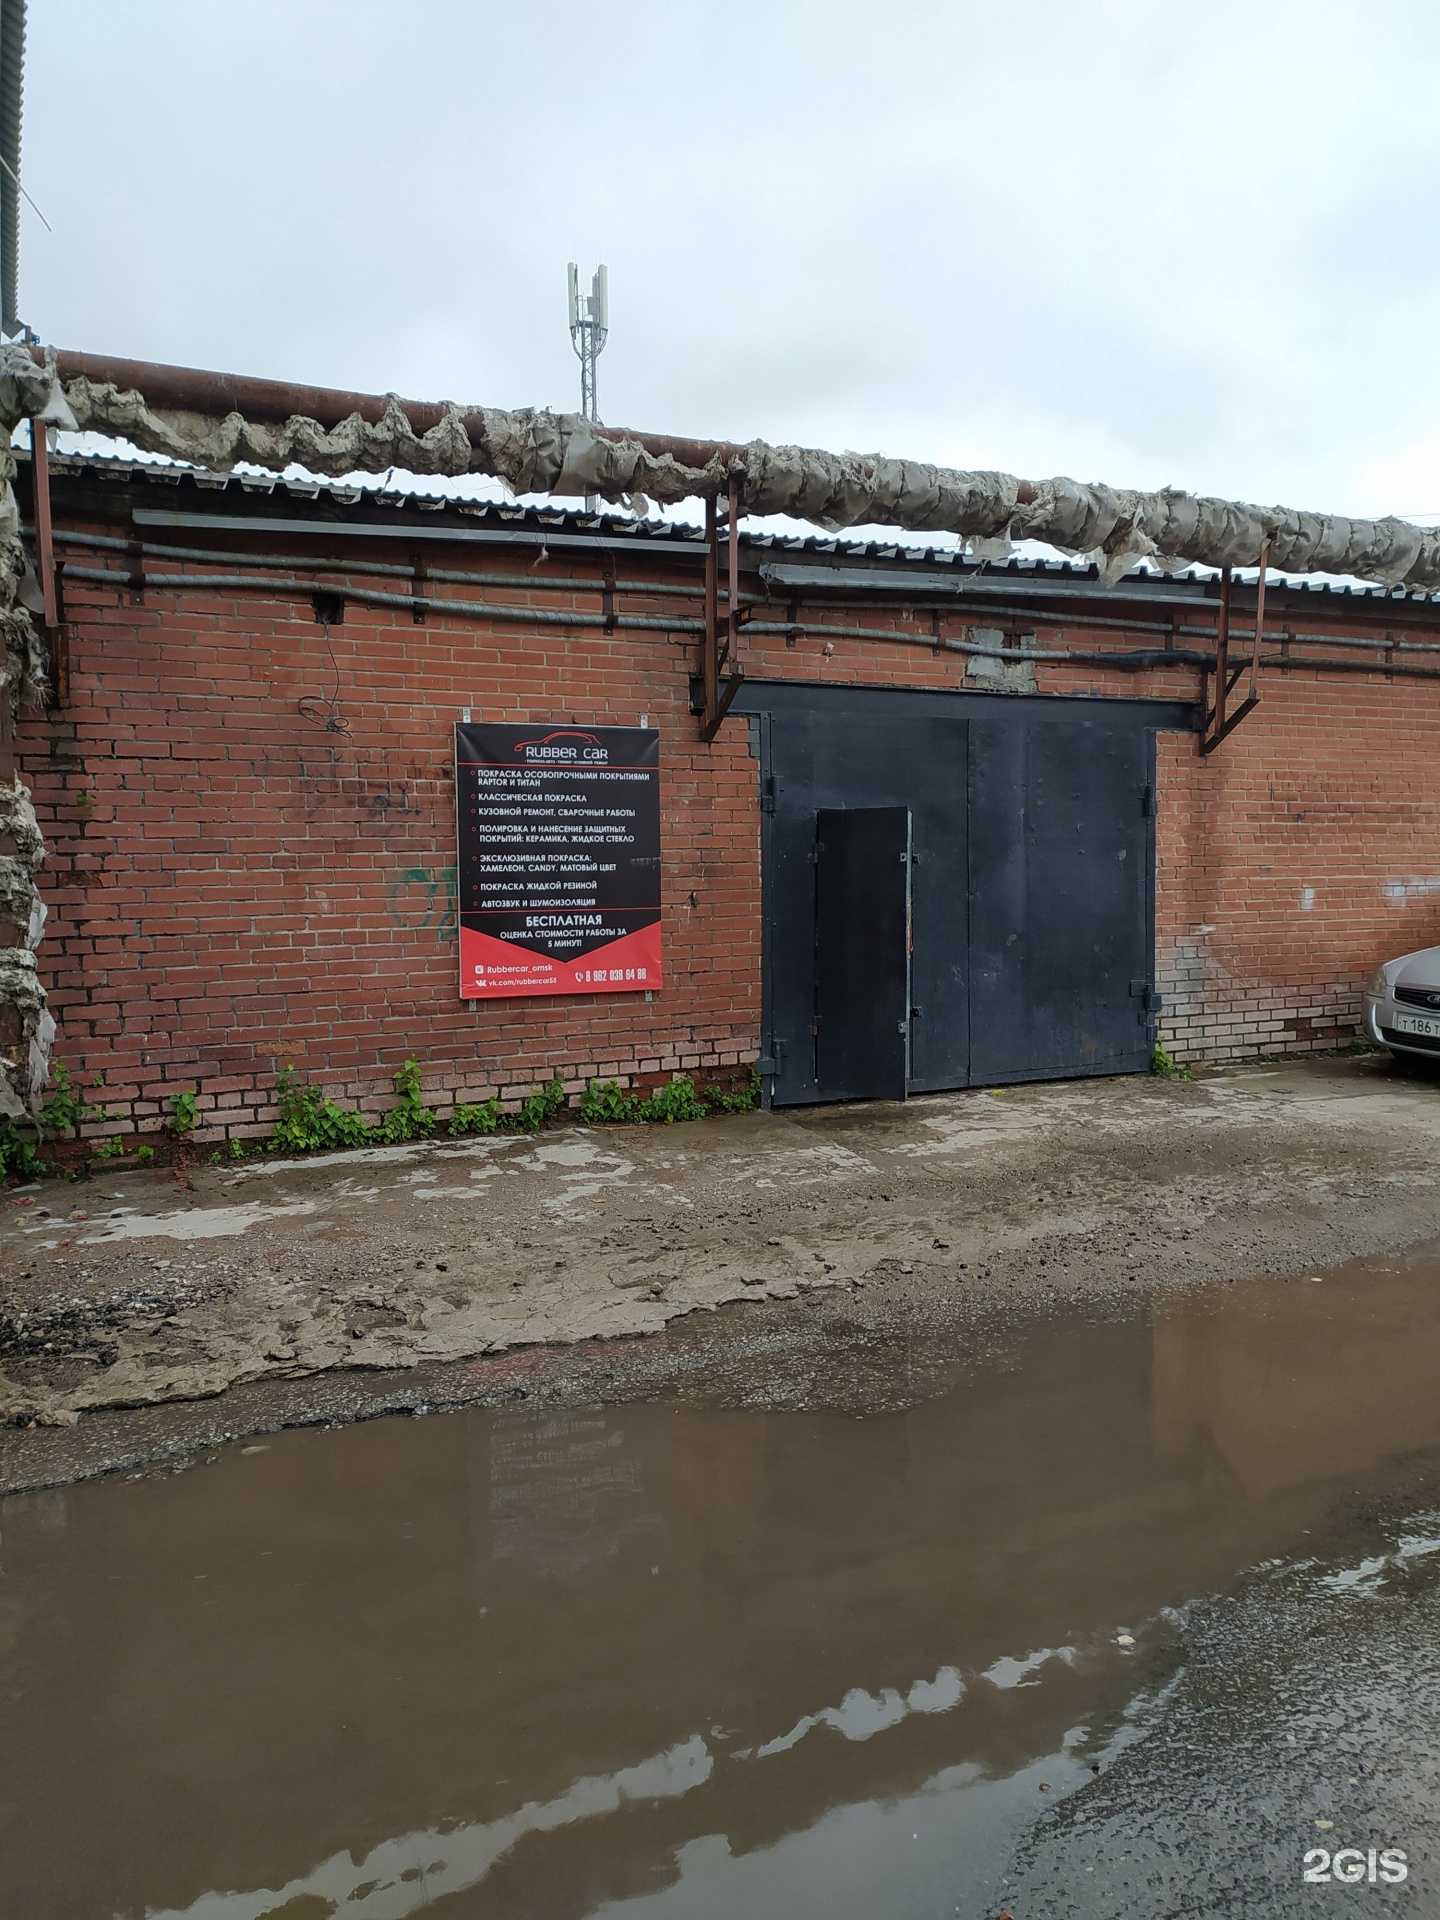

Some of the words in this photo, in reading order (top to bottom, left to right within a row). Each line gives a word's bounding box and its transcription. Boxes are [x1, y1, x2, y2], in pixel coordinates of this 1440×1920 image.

[478, 770, 522, 778] ПОКРАСКА
[525, 771, 598, 780] ОСОБОПРОЧНЫМИ
[599, 773, 650, 781] ПОКРЫТИЯМИ
[478, 778, 508, 786] RAPTOR
[517, 779, 541, 787] ТИТАН
[544, 794, 587, 802] ПОКРАСКА
[478, 807, 521, 816] КУЗОВНОЙ
[523, 809, 556, 817] РЕМОНТ,
[606, 809, 636, 817] РАБОТЫ
[479, 825, 528, 833] ПОЛИРОВКА
[530, 825, 536, 833] И
[538, 825, 582, 833] НАНЕСЕНИЕ
[584, 825, 626, 834] ЗАЩИТНЫХ
[479, 834, 524, 843] ПОКРЫТИЙ:
[571, 836, 605, 844] ЖИДКОЕ
[480, 854, 546, 862] ЭКСКЛЮЗИВНАЯ
[547, 854, 592, 862] ПОКРАСКА:
[480, 864, 526, 873] ХАМЕЛЕОН,
[528, 864, 558, 873] CANDY,
[560, 862, 598, 872] МАТОВЫЙ
[599, 864, 616, 872] ЦВЕТ
[480, 883, 524, 891] ПОКРАСКА
[526, 882, 562, 891] ЖИДКОЙ
[563, 881, 597, 889] РЕЗИНОЙ
[481, 900, 521, 908] АВТОЗВУК
[530, 899, 596, 907] ШУМОИЗОЛЯЦИЯ
[526, 915, 602, 927] БЕСПЛАТНАЯ
[500, 931, 533, 940] ОЦЕНКА
[535, 930, 584, 938] СТОИМОСТИ
[586, 929, 616, 937] РАБОТЫ
[617, 928, 627, 936] ЗА
[547, 940, 553, 948] 5
[487, 964, 553, 974] Rubbercar_omsk
